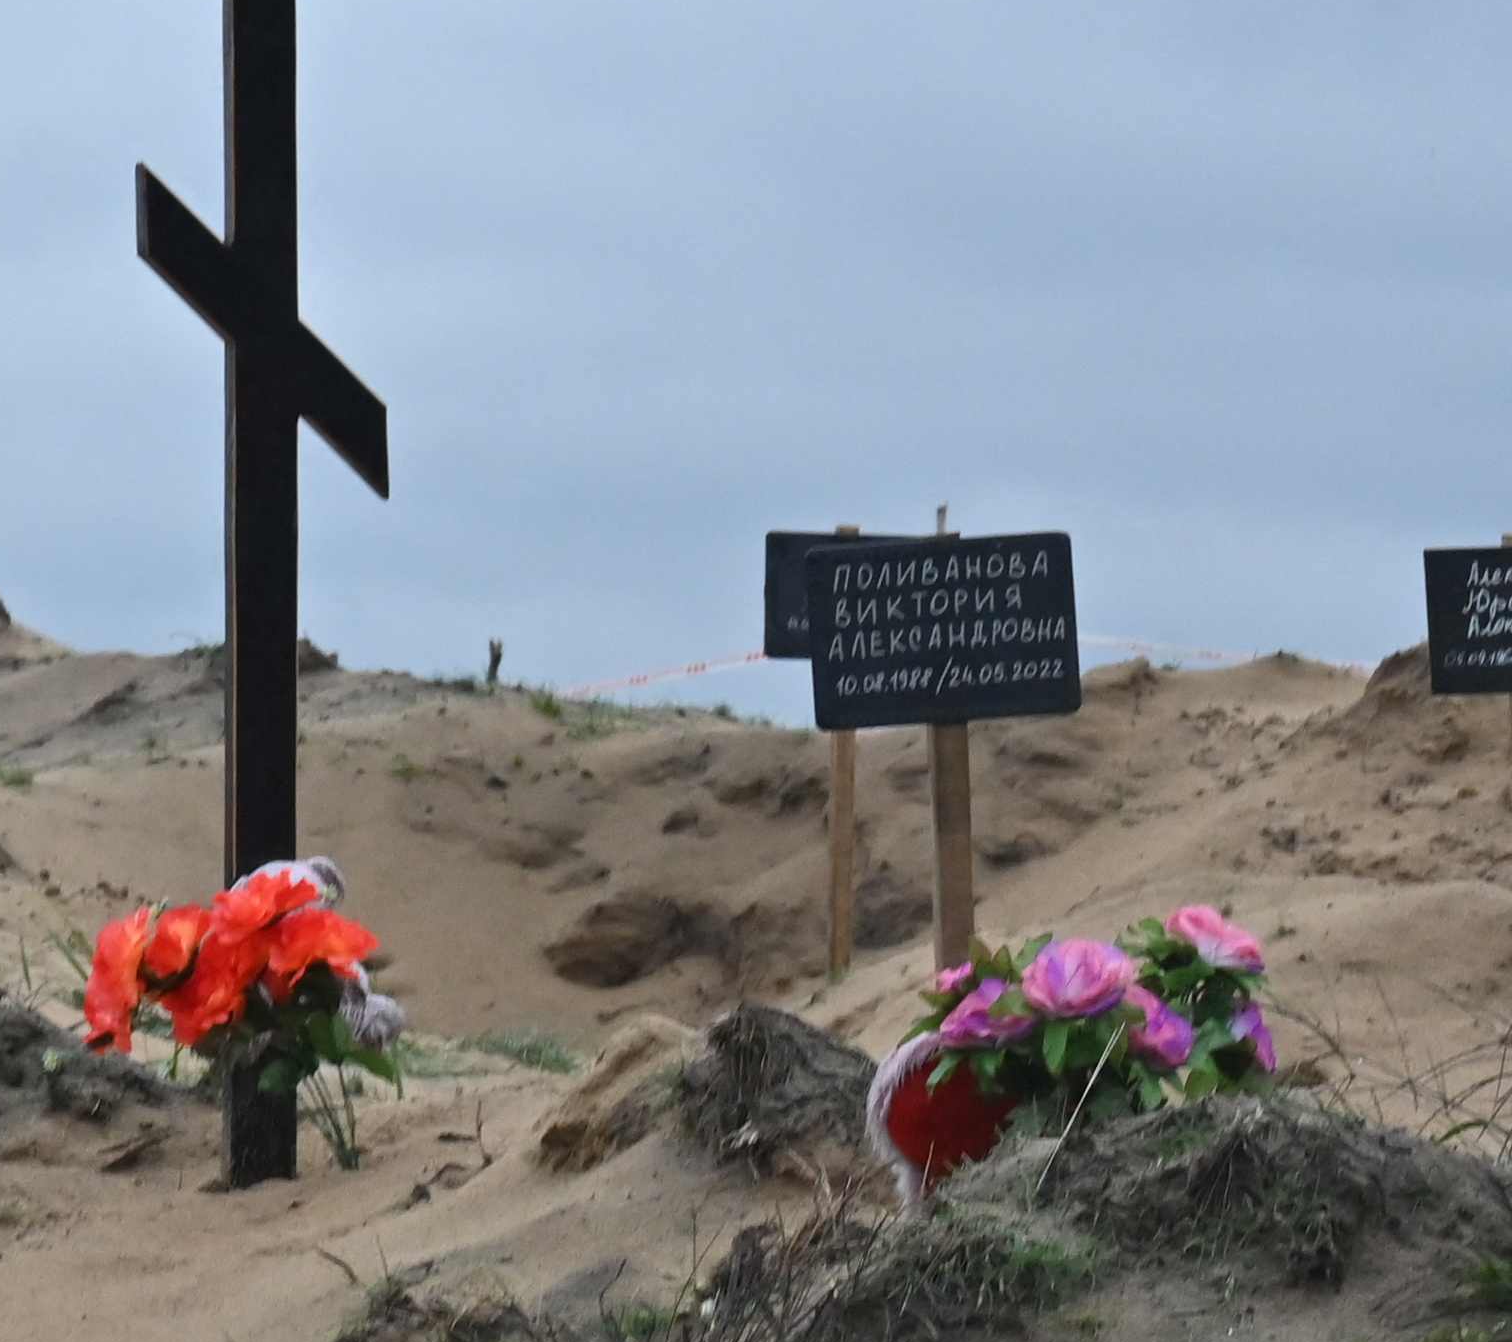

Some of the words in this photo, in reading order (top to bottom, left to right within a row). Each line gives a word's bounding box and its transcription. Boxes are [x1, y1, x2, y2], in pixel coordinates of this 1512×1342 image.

[832, 549, 1049, 596] ПОЛИВАНОВА
[834, 582, 1023, 630] ВИКТОРИЯ
[827, 615, 1066, 663] АЛЕКСАНДРОВНА
